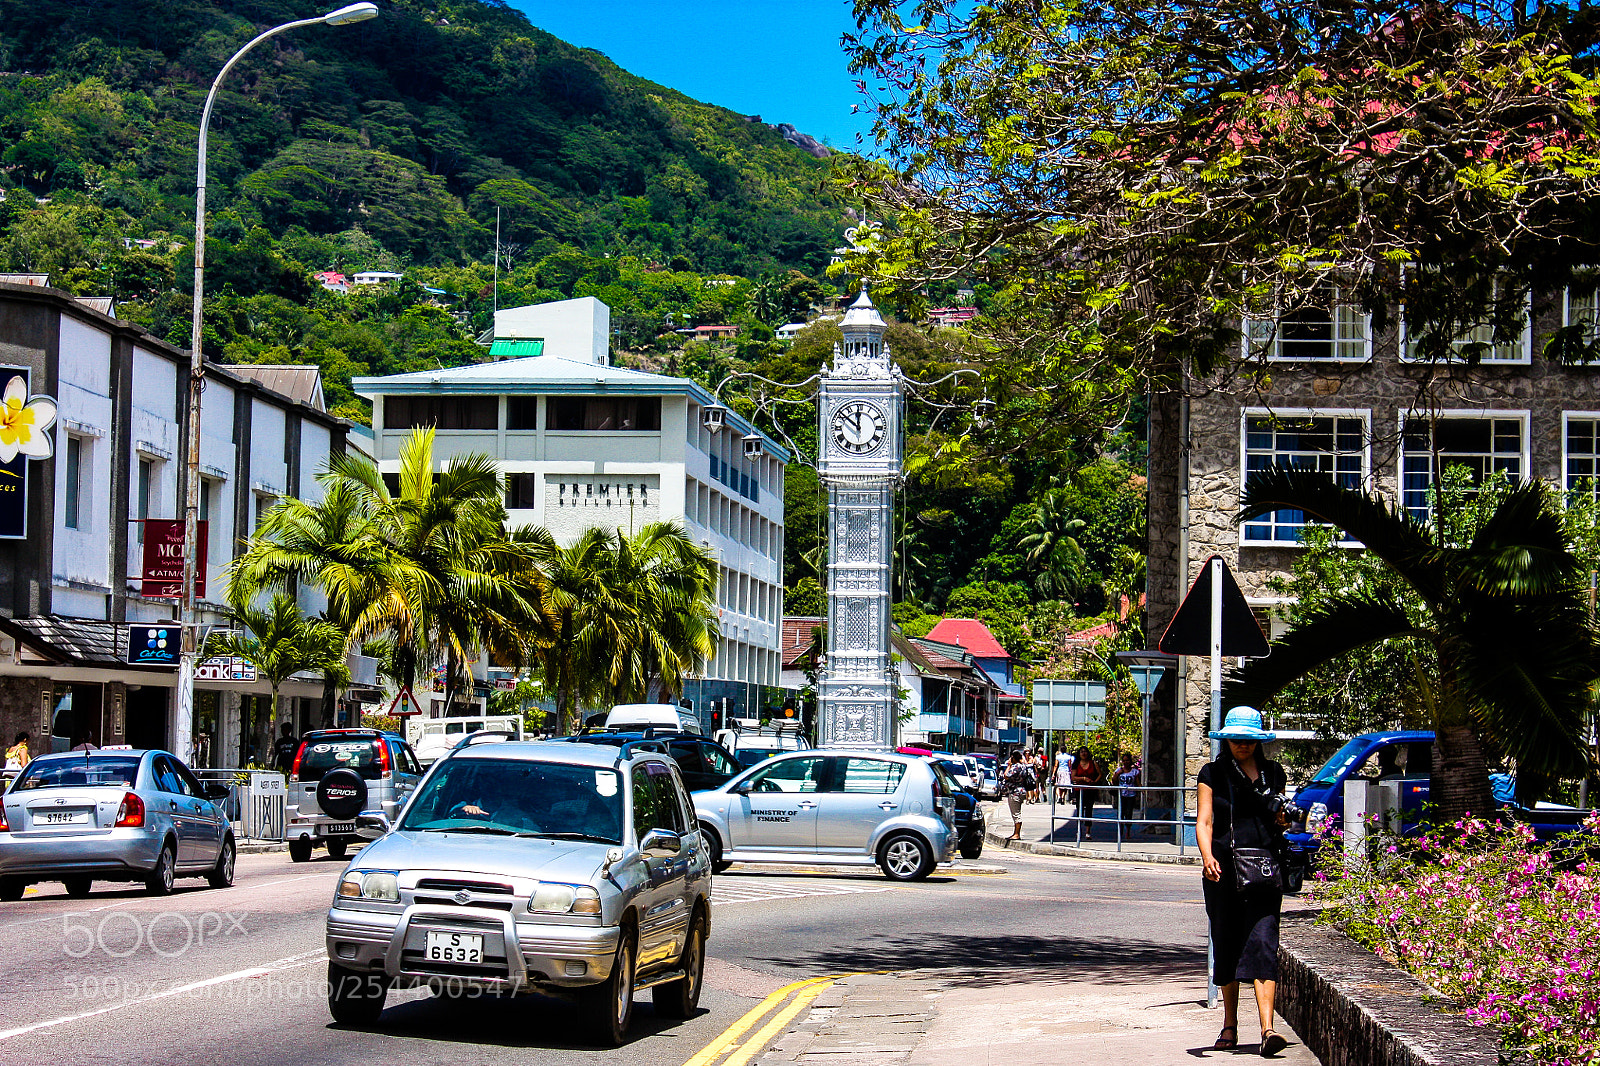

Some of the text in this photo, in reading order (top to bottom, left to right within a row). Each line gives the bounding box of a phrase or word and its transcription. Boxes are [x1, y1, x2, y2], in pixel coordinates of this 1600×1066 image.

[559, 483, 648, 497] PREMIER
[559, 498, 649, 509] BUILDING
[326, 788, 358, 797] TERIOS
[47, 812, 73, 824] S7642
[449, 933, 462, 947] S
[430, 945, 480, 963] 6632
